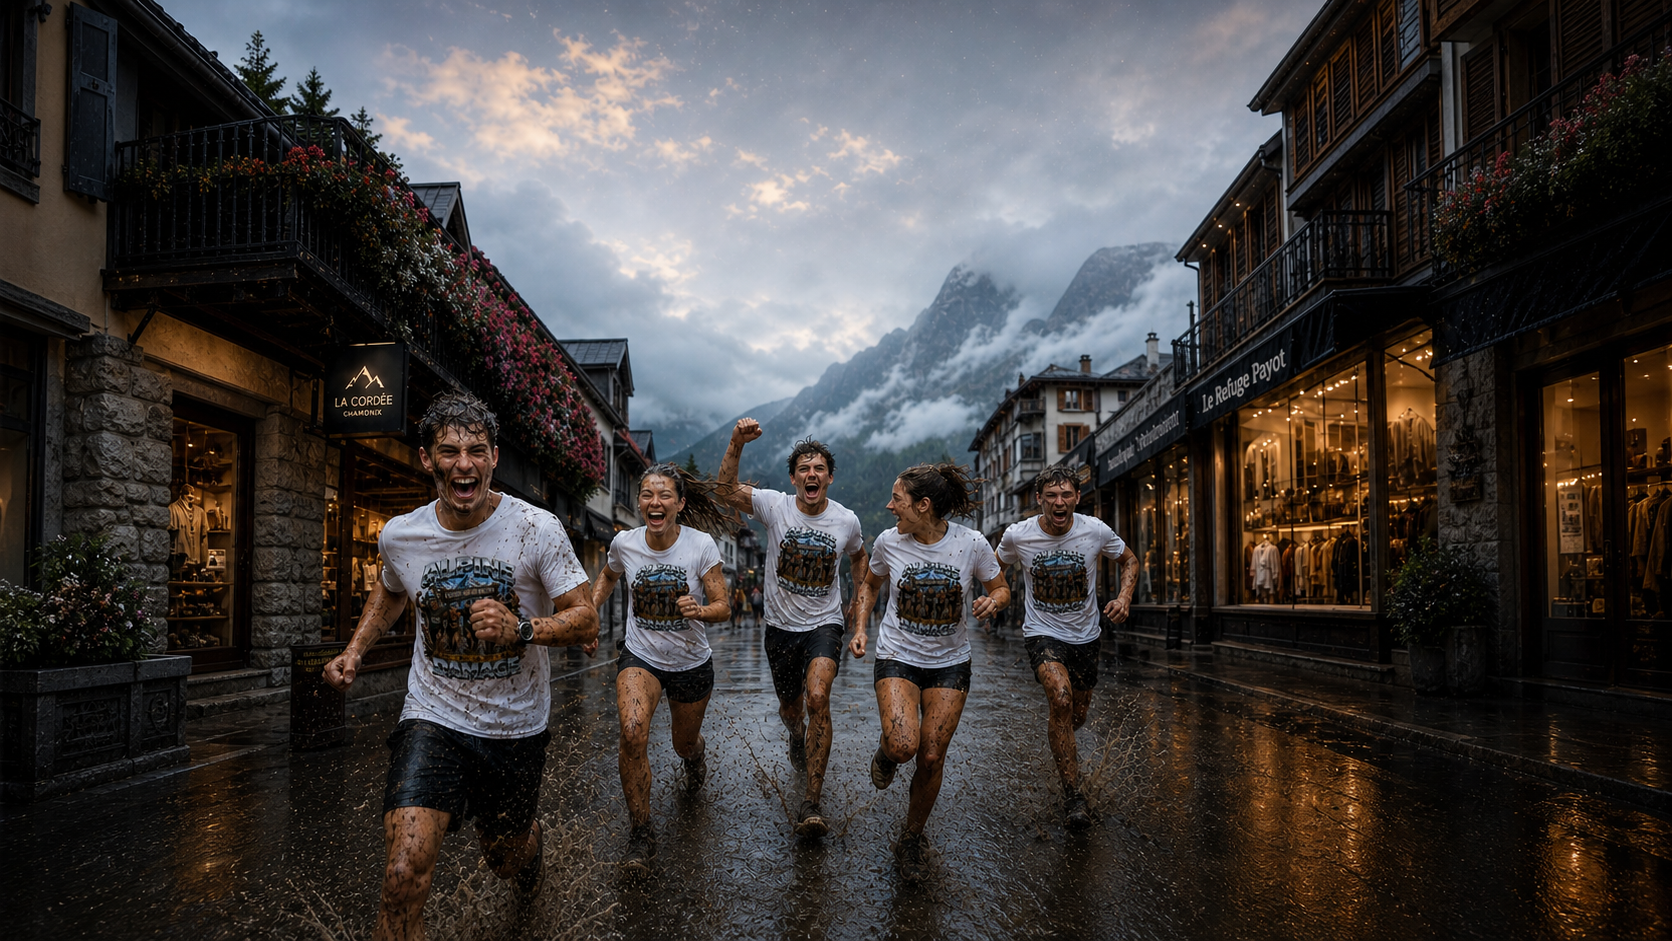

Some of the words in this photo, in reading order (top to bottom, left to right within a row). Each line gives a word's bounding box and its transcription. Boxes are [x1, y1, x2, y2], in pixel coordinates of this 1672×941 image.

[1202, 393, 1214, 413] Le
[1215, 373, 1250, 406] Refuge
[1251, 348, 1287, 384] Payot
[334, 397, 348, 408] LA
[350, 392, 393, 407] CORDÉE
[343, 409, 382, 417] CHAMONIX
[421, 556, 516, 588] ALPINE
[432, 655, 522, 680] DAMAGE
